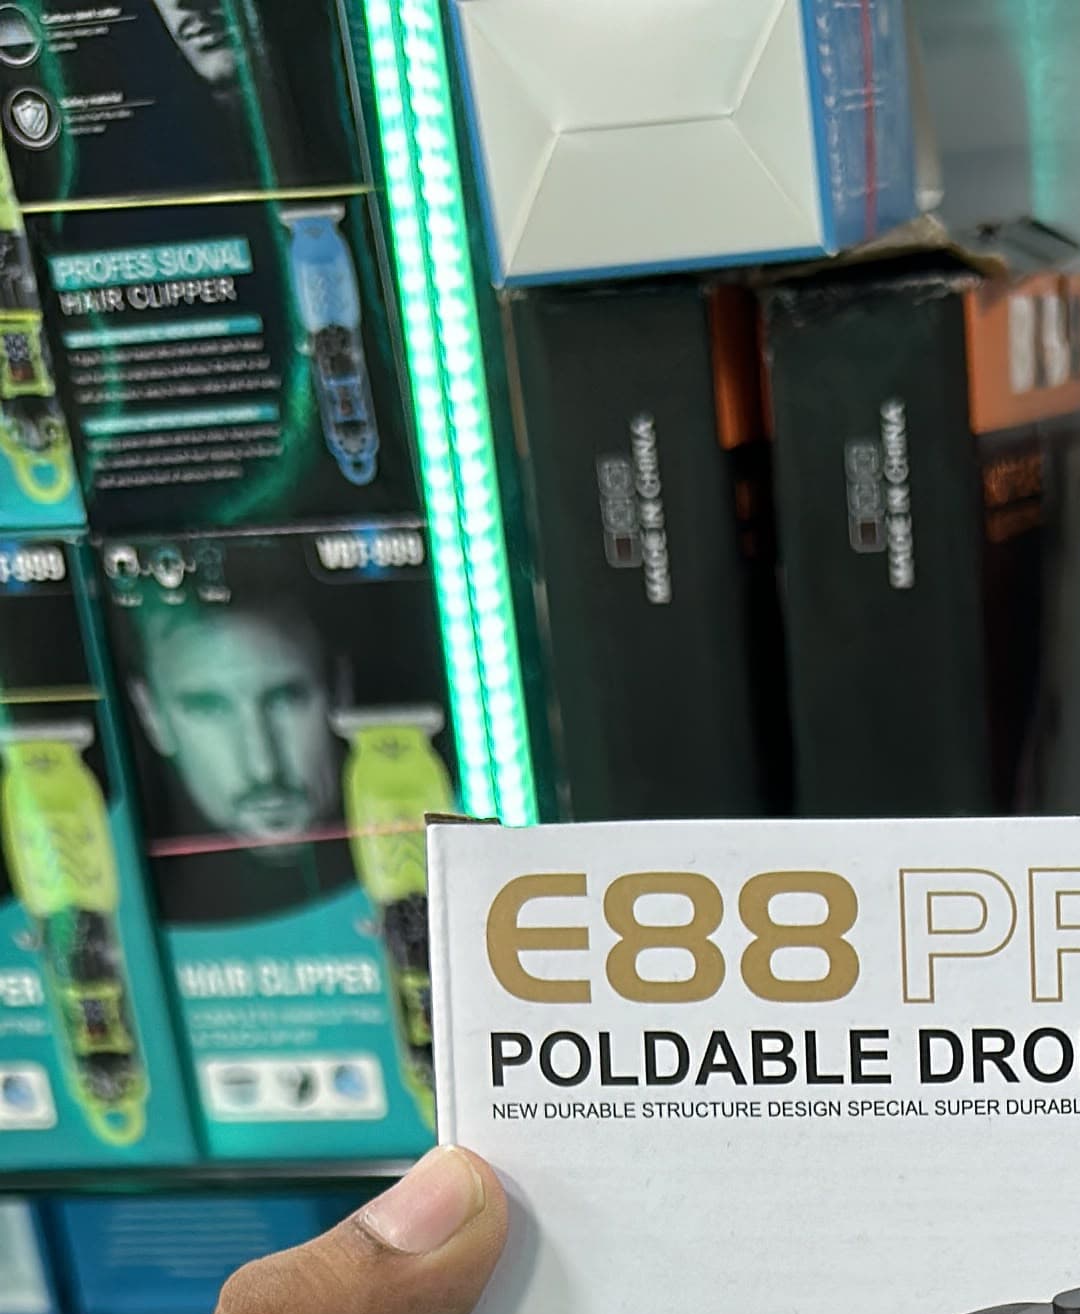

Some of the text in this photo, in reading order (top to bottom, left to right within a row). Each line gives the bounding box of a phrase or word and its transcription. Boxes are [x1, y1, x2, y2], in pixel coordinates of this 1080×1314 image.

[59, 276, 237, 316] HAIR CLIPPER
[486, 871, 859, 1003] E88
[490, 1029, 892, 1087] POLDABLE
[492, 1103, 539, 1120] NEW
[544, 1102, 636, 1119] DURABLE
[642, 1101, 762, 1119] STRUCTURE
[767, 1100, 841, 1118] DESIGN
[847, 1099, 929, 1117] SPECIAL
[934, 1099, 1001, 1116] SUPER
